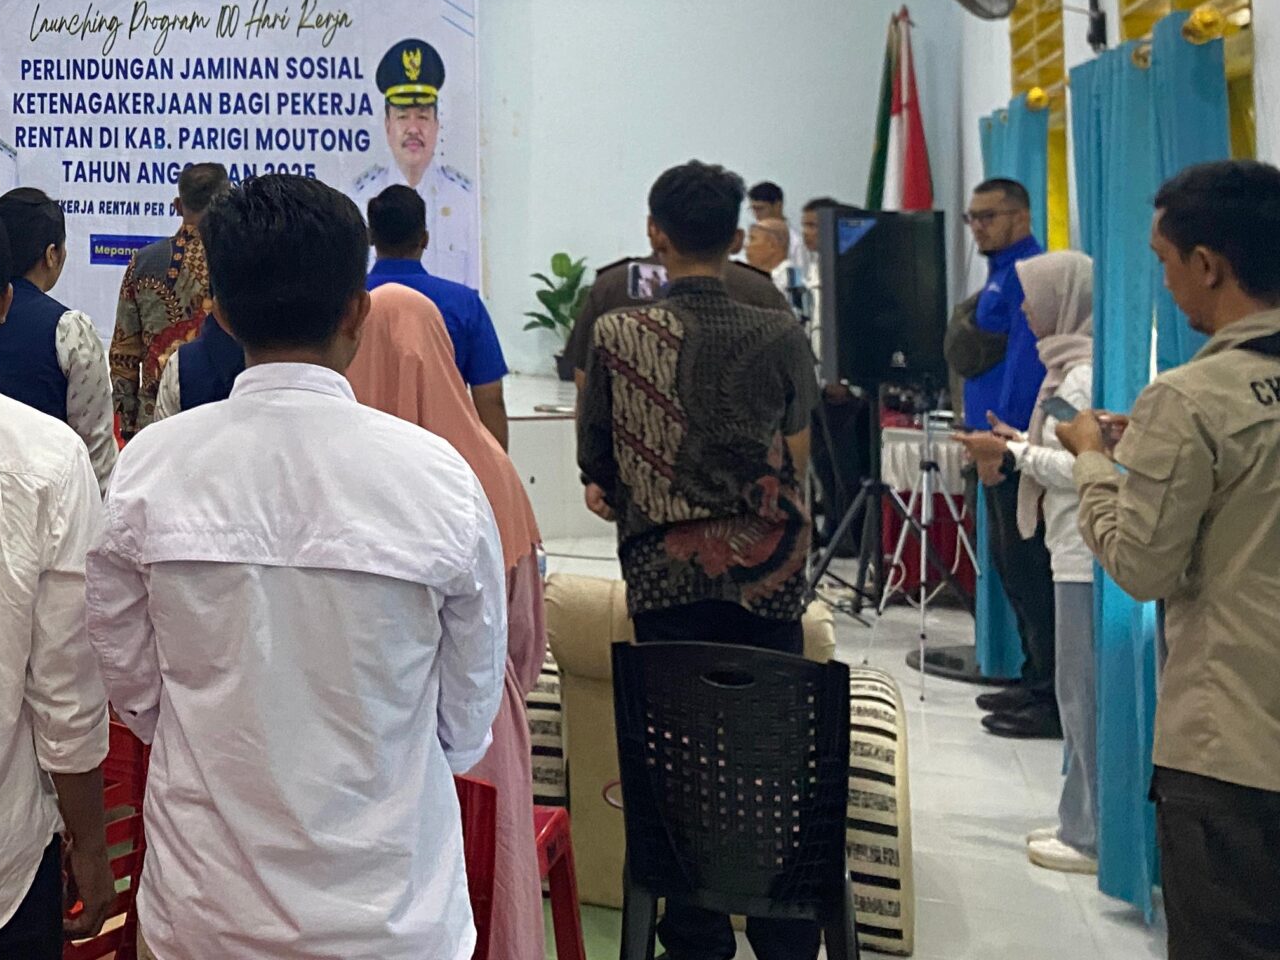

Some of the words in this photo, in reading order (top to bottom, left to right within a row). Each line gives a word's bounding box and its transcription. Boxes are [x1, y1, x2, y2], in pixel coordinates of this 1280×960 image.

[29, 2, 123, 56] Launching
[128, 0, 210, 56] Program
[216, 4, 240, 38] 100
[21, 58, 173, 80] PERLINDUNGAN
[180, 57, 279, 80] JAMINAN
[286, 56, 364, 80] SOSIAL
[12, 92, 212, 115] KETENAGAKERJAAN
[219, 92, 270, 115] BAGI
[277, 92, 373, 116] PEKERJA
[15, 126, 93, 149] RENTAN
[99, 127, 118, 149] DI
[125, 127, 172, 149] KAB.
[178, 127, 248, 150] PARIGI
[255, 128, 370, 152] MOUTONG
[62, 161, 131, 183] TAHUN
[99, 200, 139, 215] RENTAN
[144, 202, 164, 216] PER
